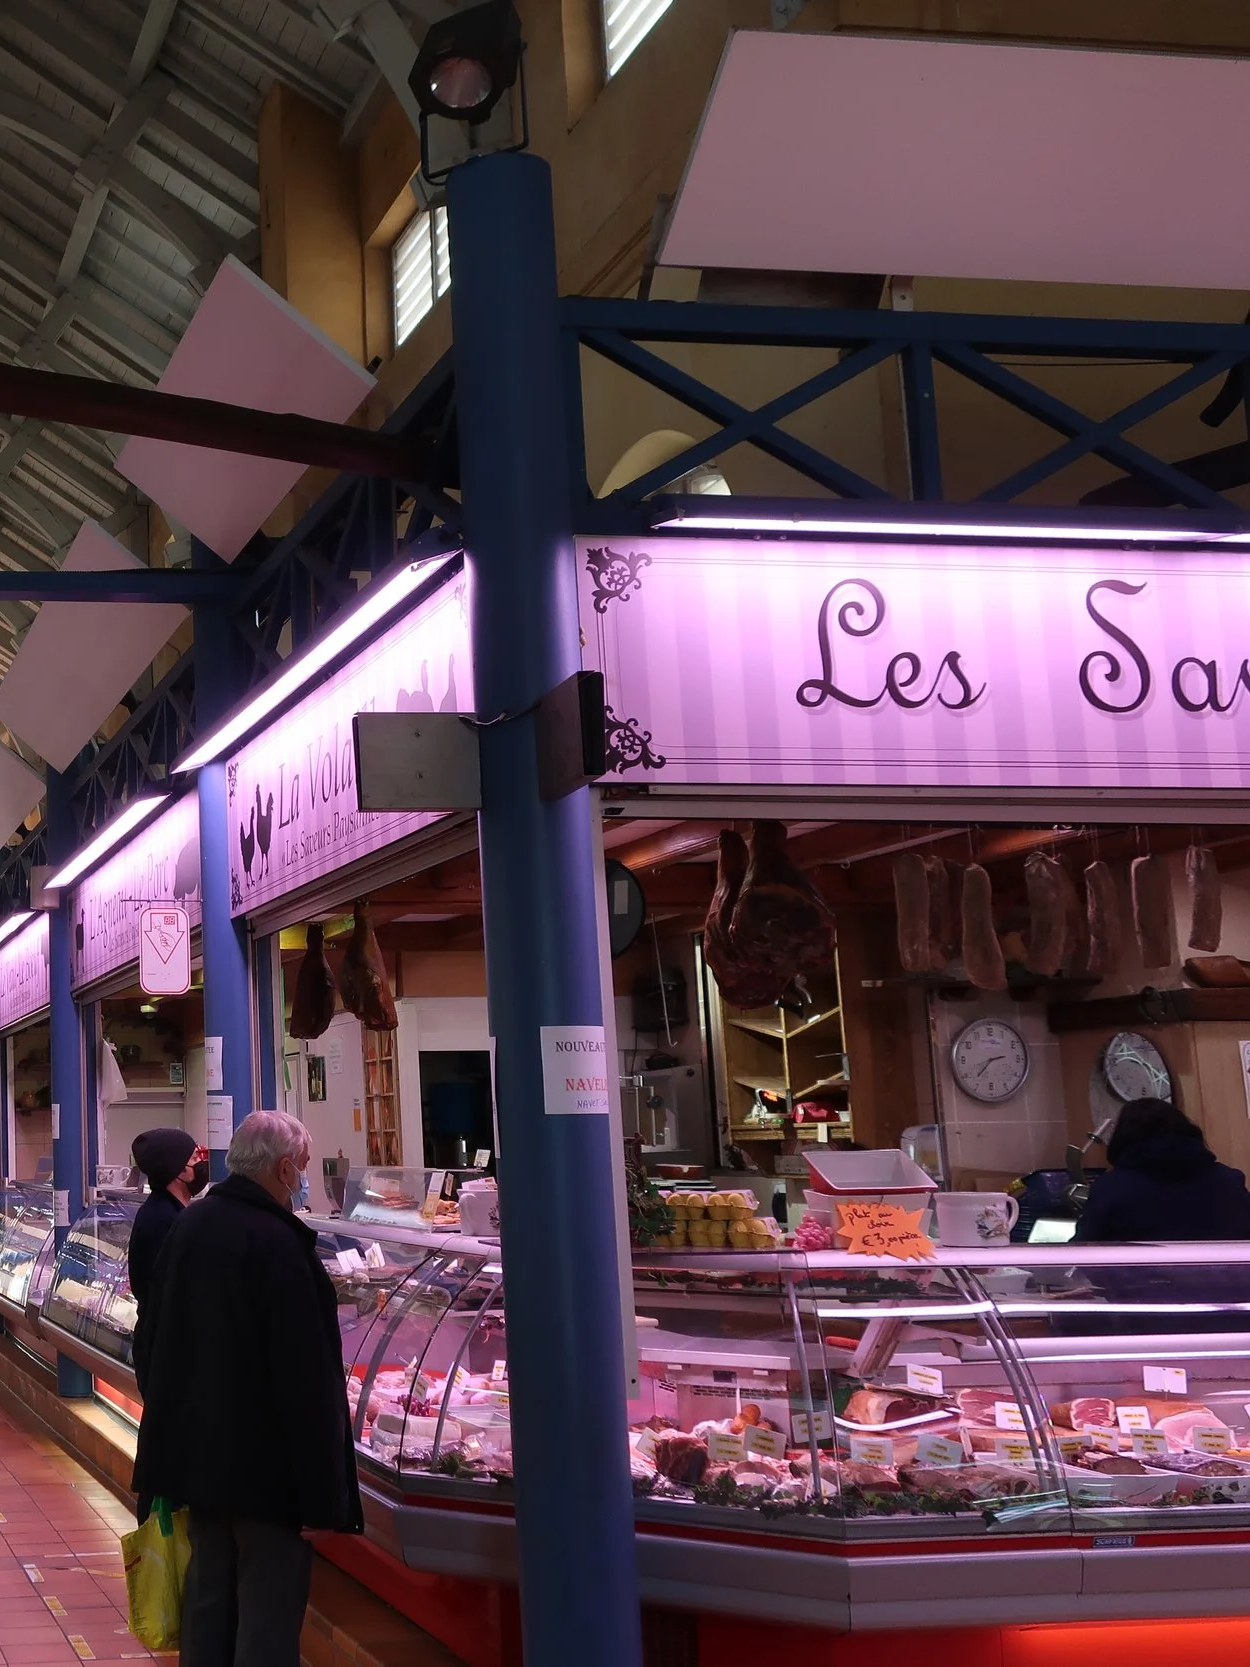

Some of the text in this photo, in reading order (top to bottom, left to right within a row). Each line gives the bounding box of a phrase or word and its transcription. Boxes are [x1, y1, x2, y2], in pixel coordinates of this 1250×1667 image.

[796, 578, 987, 709] Les
[278, 721, 355, 830] La Vola
